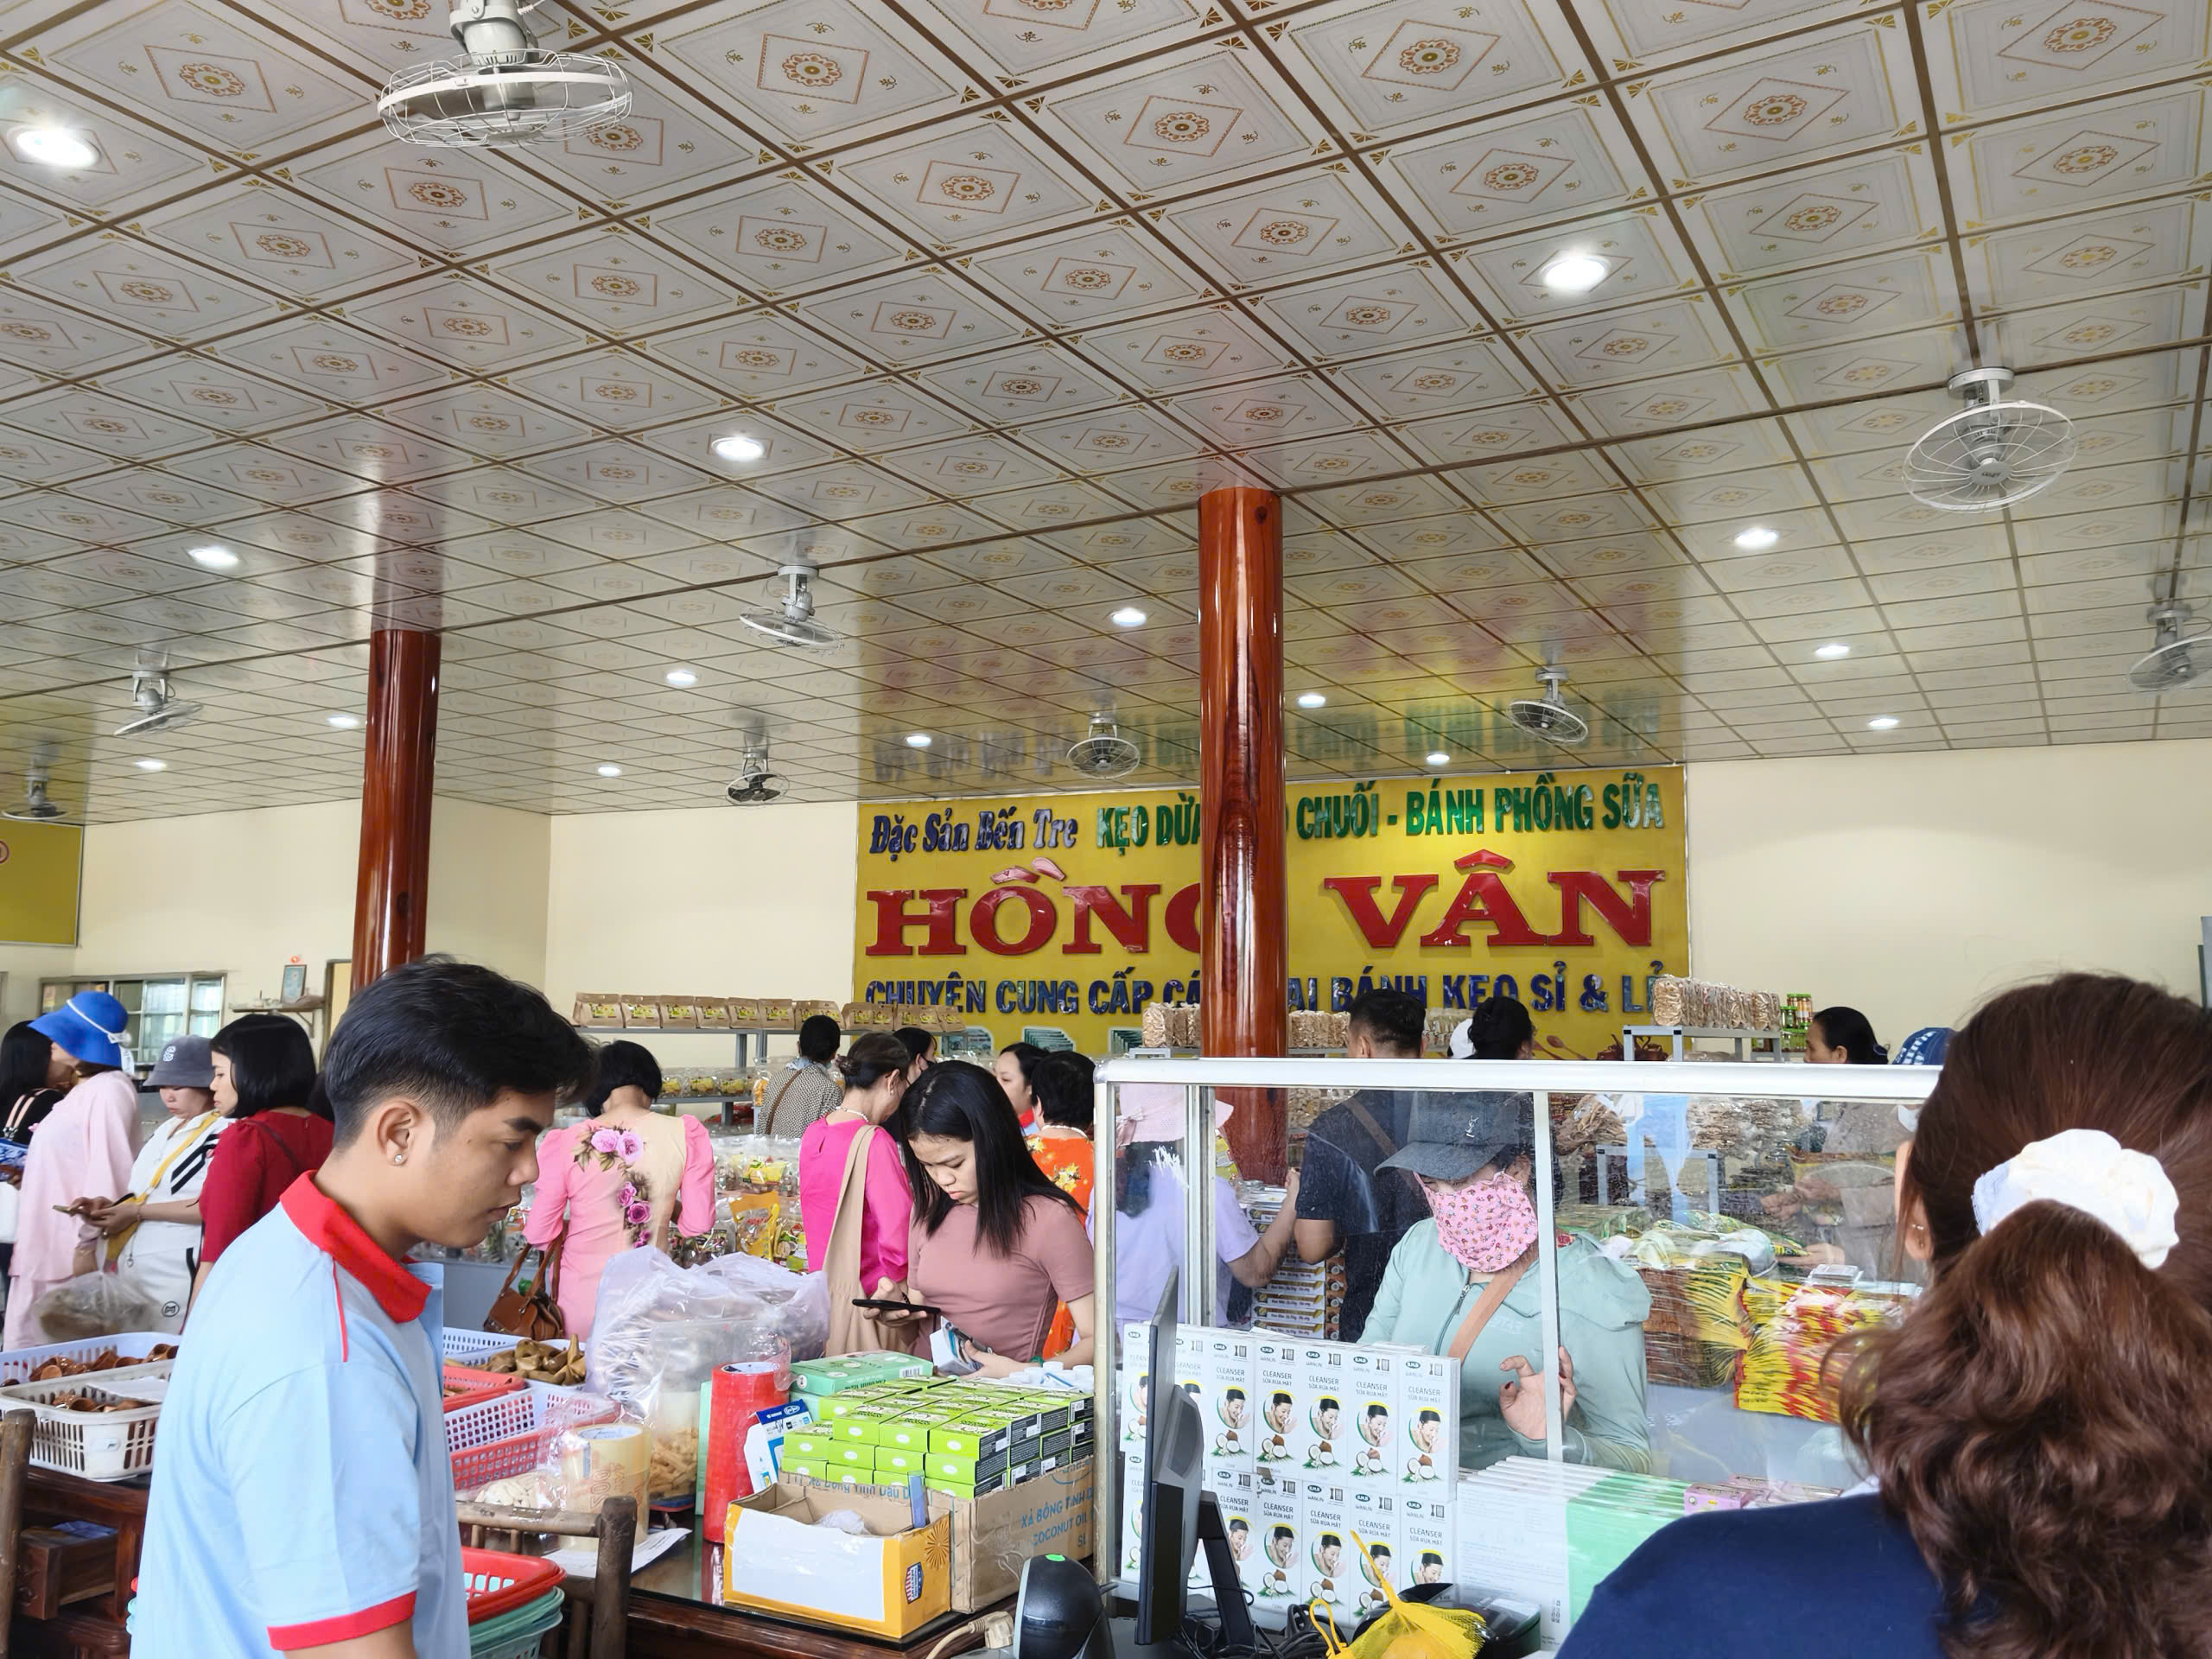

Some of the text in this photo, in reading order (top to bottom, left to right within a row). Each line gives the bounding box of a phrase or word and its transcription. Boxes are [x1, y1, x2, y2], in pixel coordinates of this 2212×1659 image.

[1297, 780, 1379, 839] CHUỐI
[1406, 778, 1484, 836] BÁNH
[1495, 773, 1592, 831] PHỒNG
[1602, 773, 1664, 830] SỮA
[869, 806, 1077, 861] Đặc Sản Bến Tre
[1096, 805, 1148, 856] KẸO
[1324, 849, 1666, 949] VÂN
[866, 967, 1200, 1014] CHUYÊN CUNG CẤP CÁ
[1580, 975, 1609, 1012] &
[1217, 1367, 1244, 1376] CLEANSER
[1263, 1370, 1292, 1380] CLEANSER
[1309, 1376, 1339, 1385] CLEANSER
[1356, 1382, 1388, 1391] CLEANSER
[1408, 1386, 1440, 1395] CLEANSER
[1220, 1496, 1249, 1506] CLEANSER
[1264, 1503, 1294, 1513] CLEANSER
[1310, 1510, 1341, 1521] CLEANSER
[1358, 1520, 1390, 1530] CLEANSER
[1410, 1528, 1442, 1538] CLEANSER
